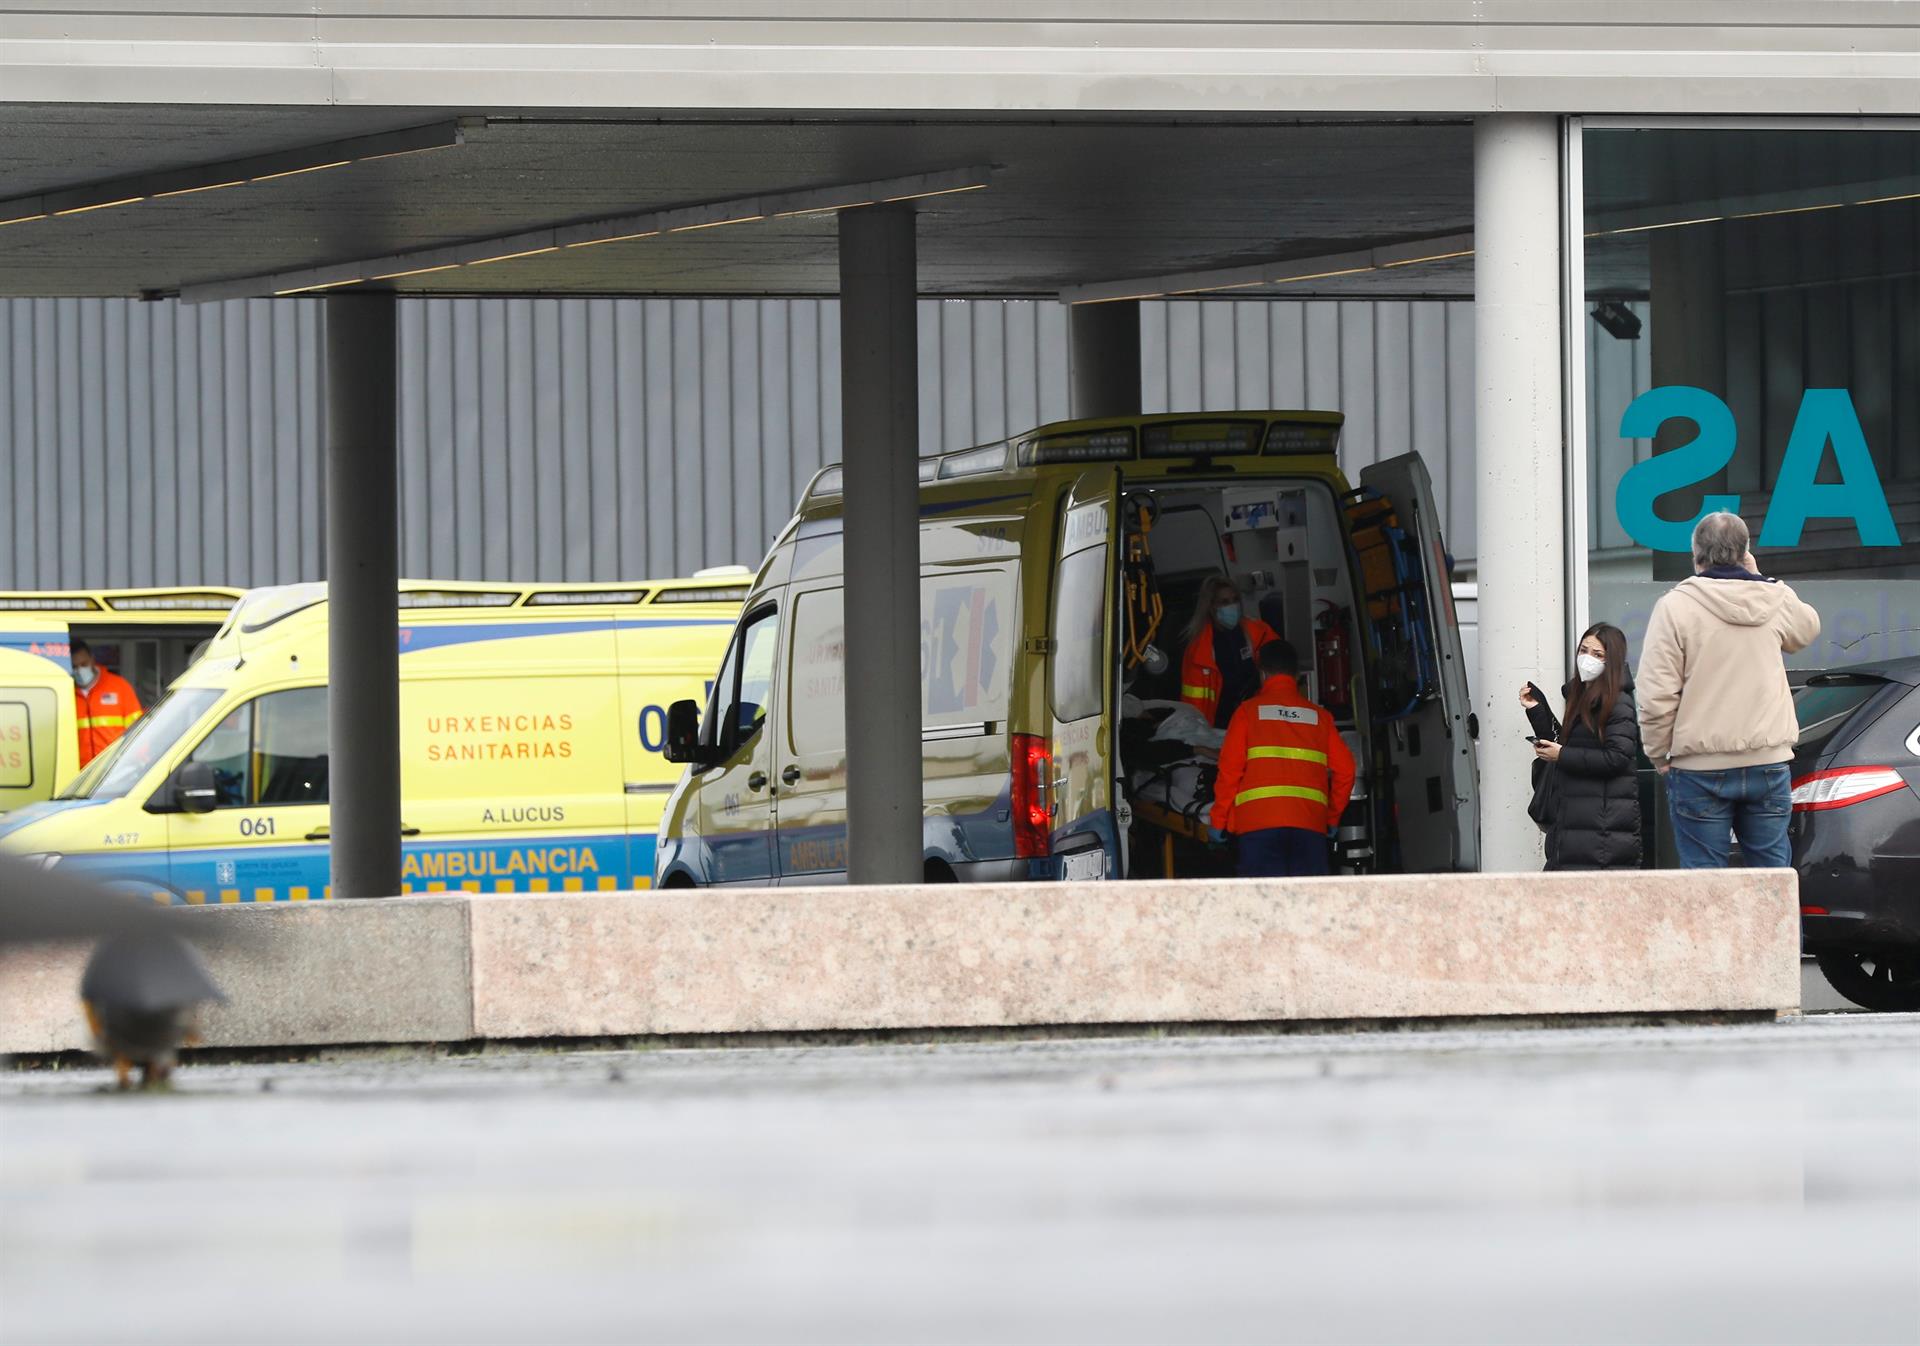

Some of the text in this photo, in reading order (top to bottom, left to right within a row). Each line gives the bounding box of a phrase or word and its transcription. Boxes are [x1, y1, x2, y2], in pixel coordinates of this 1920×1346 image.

[428, 714, 573, 733] URXENCIAS
[1278, 709, 1300, 719] T.E.S.
[428, 741, 572, 761] SANITARIAS
[724, 793, 740, 816] 061
[482, 806, 565, 823] A.LUCUS
[239, 817, 276, 836] 061
[401, 847, 599, 878] AMBULANCIA
